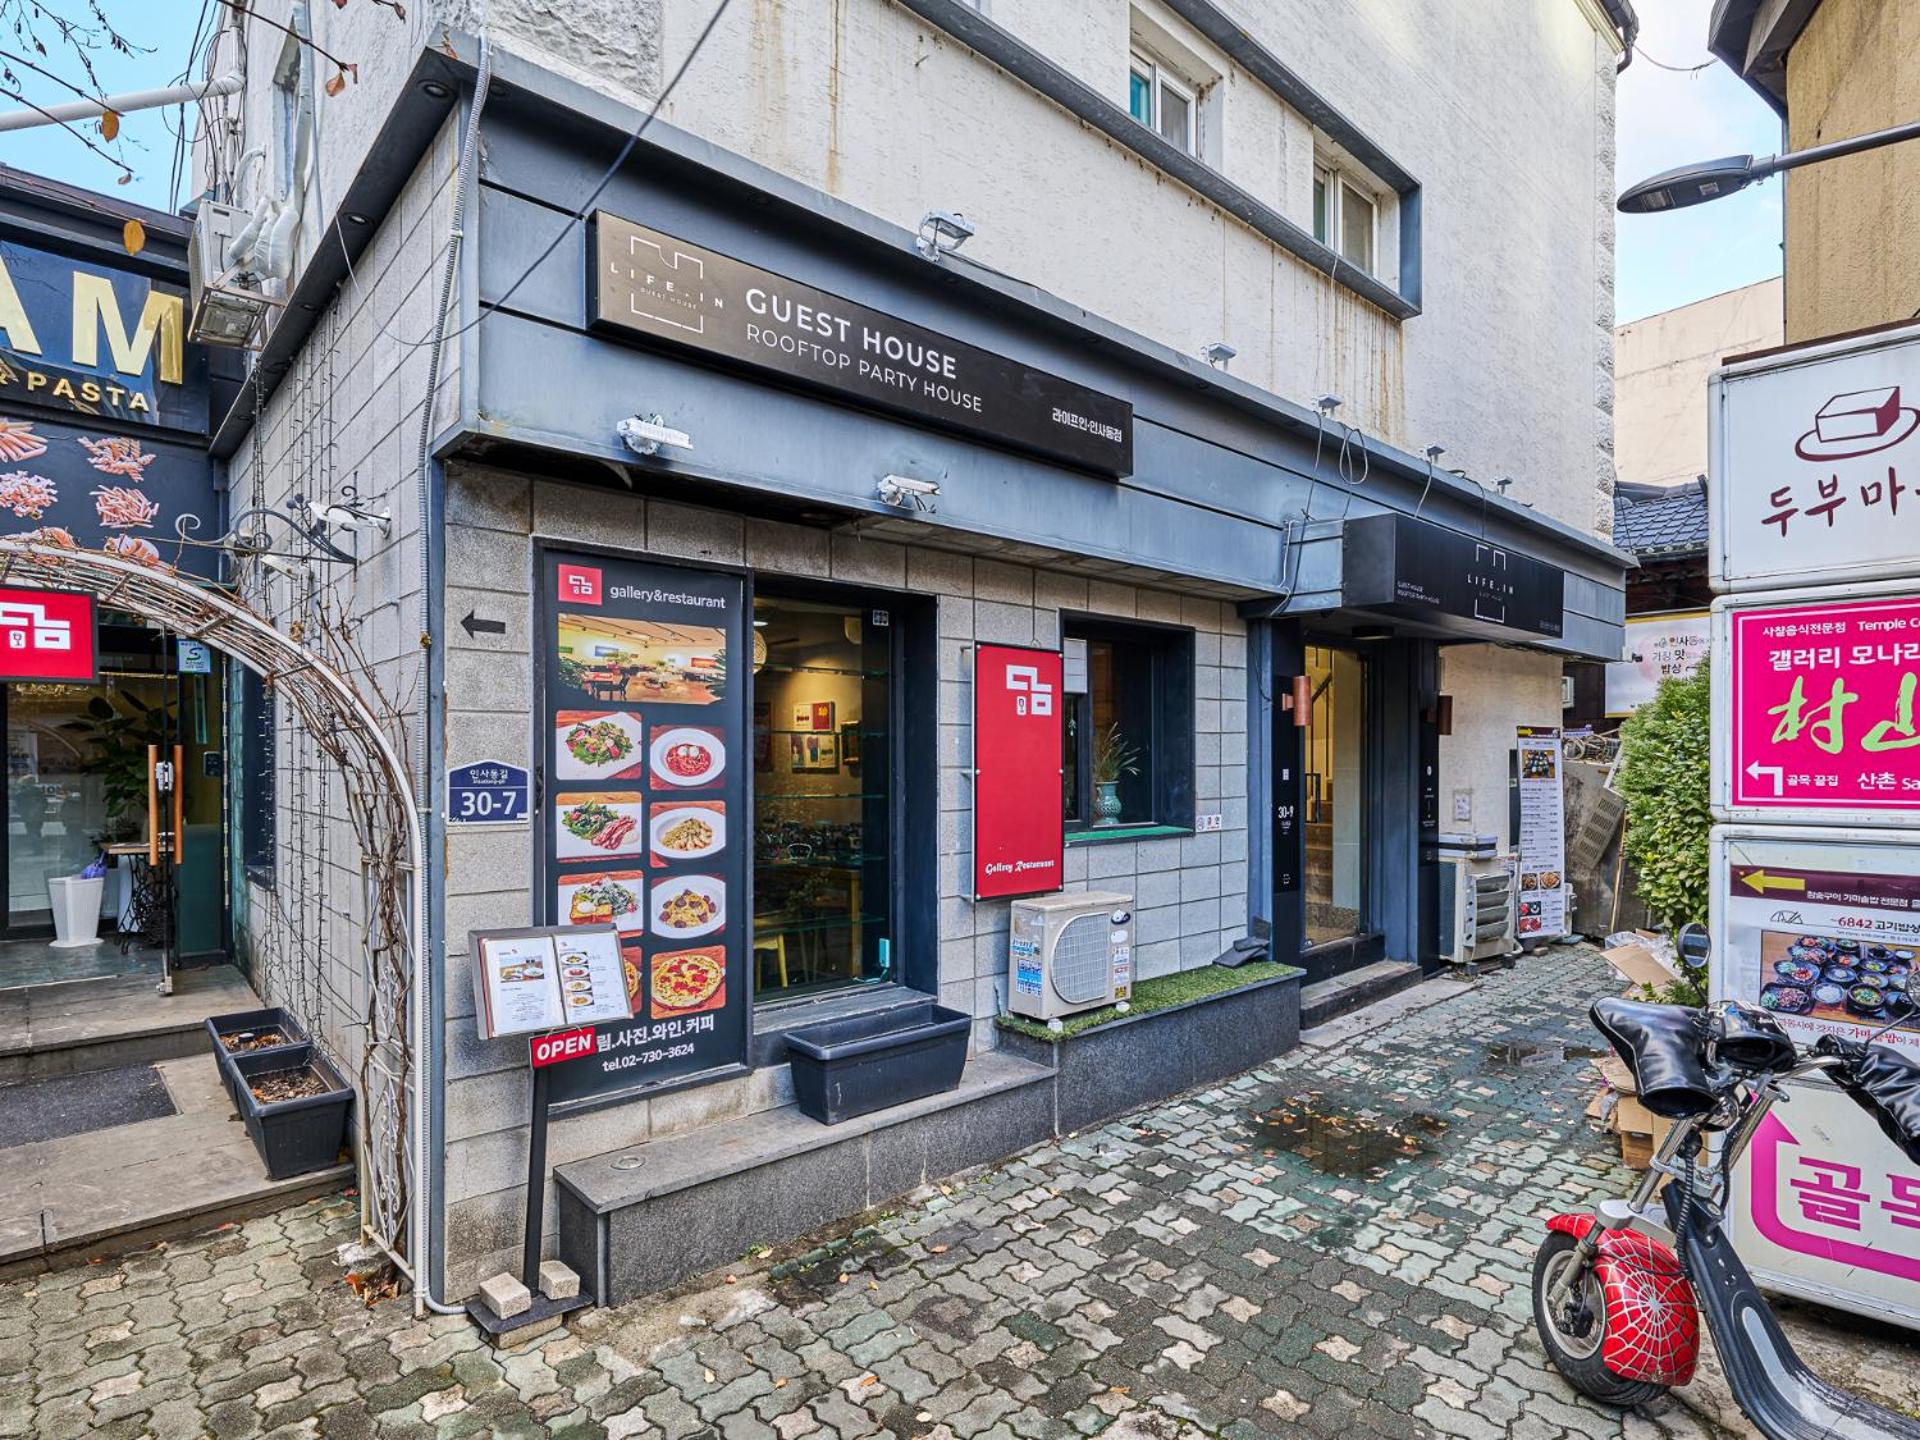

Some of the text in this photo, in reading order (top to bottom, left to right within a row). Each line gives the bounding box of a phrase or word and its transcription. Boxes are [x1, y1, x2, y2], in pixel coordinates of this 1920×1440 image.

[745, 288, 957, 379] GUEST HOUSE
[746, 323, 983, 413] ROOFTOP PARTY HOUSE
[27, 371, 149, 412] PASTA
[1760, 466, 1920, 538] 두부마
[610, 585, 727, 609] gallery&restaurant
[1857, 618, 1907, 631] Temple
[1769, 646, 1840, 671] 갤러리
[1857, 771, 1920, 790] 산촌 Sa
[460, 791, 517, 816] 30-7
[1278, 805, 1294, 819] 30-9
[985, 860, 1054, 877] Gallery Restaurant
[537, 1033, 592, 1061] OPEN
[602, 1042, 695, 1072] tel.02-730-3624
